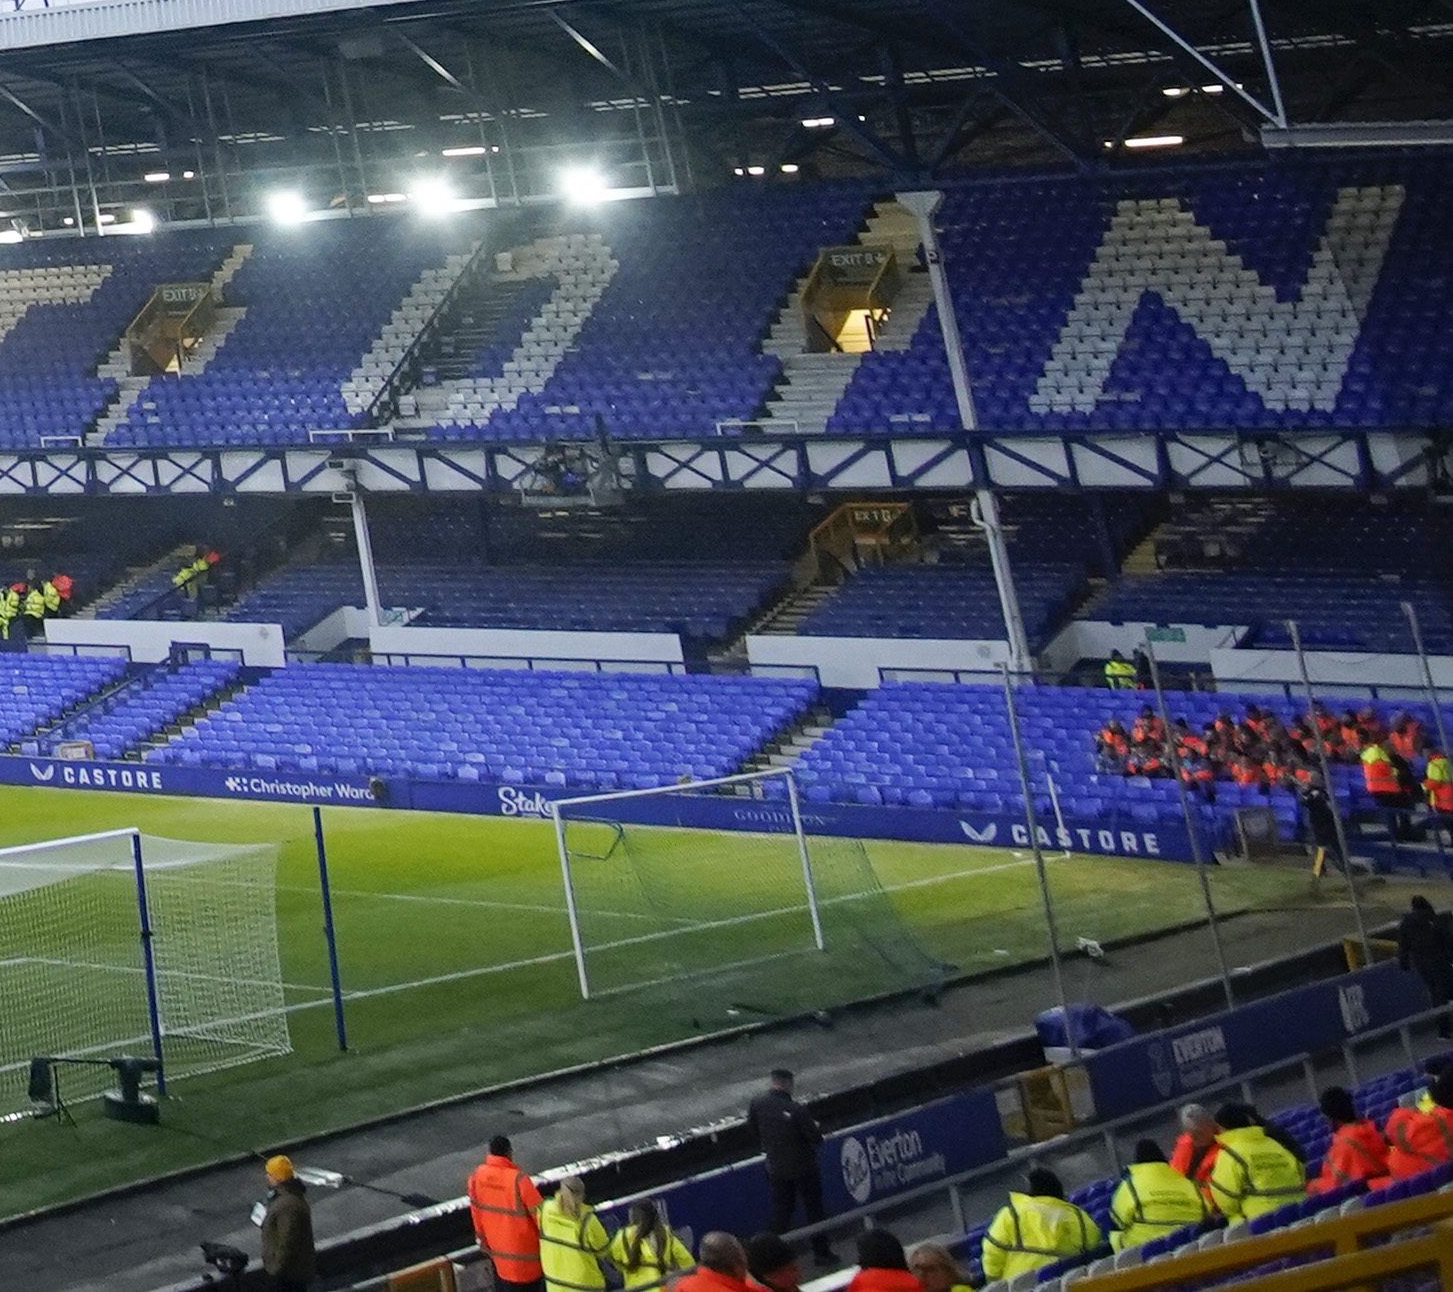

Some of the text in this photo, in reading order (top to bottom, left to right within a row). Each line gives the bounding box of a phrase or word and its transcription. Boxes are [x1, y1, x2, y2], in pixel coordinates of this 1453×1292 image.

[64, 766, 163, 790] CASTORE
[250, 778, 336, 799] Christopher
[734, 810, 827, 826] GOODION
[1011, 823, 1160, 855] CASTORE
[866, 1129, 922, 1170] Everton
